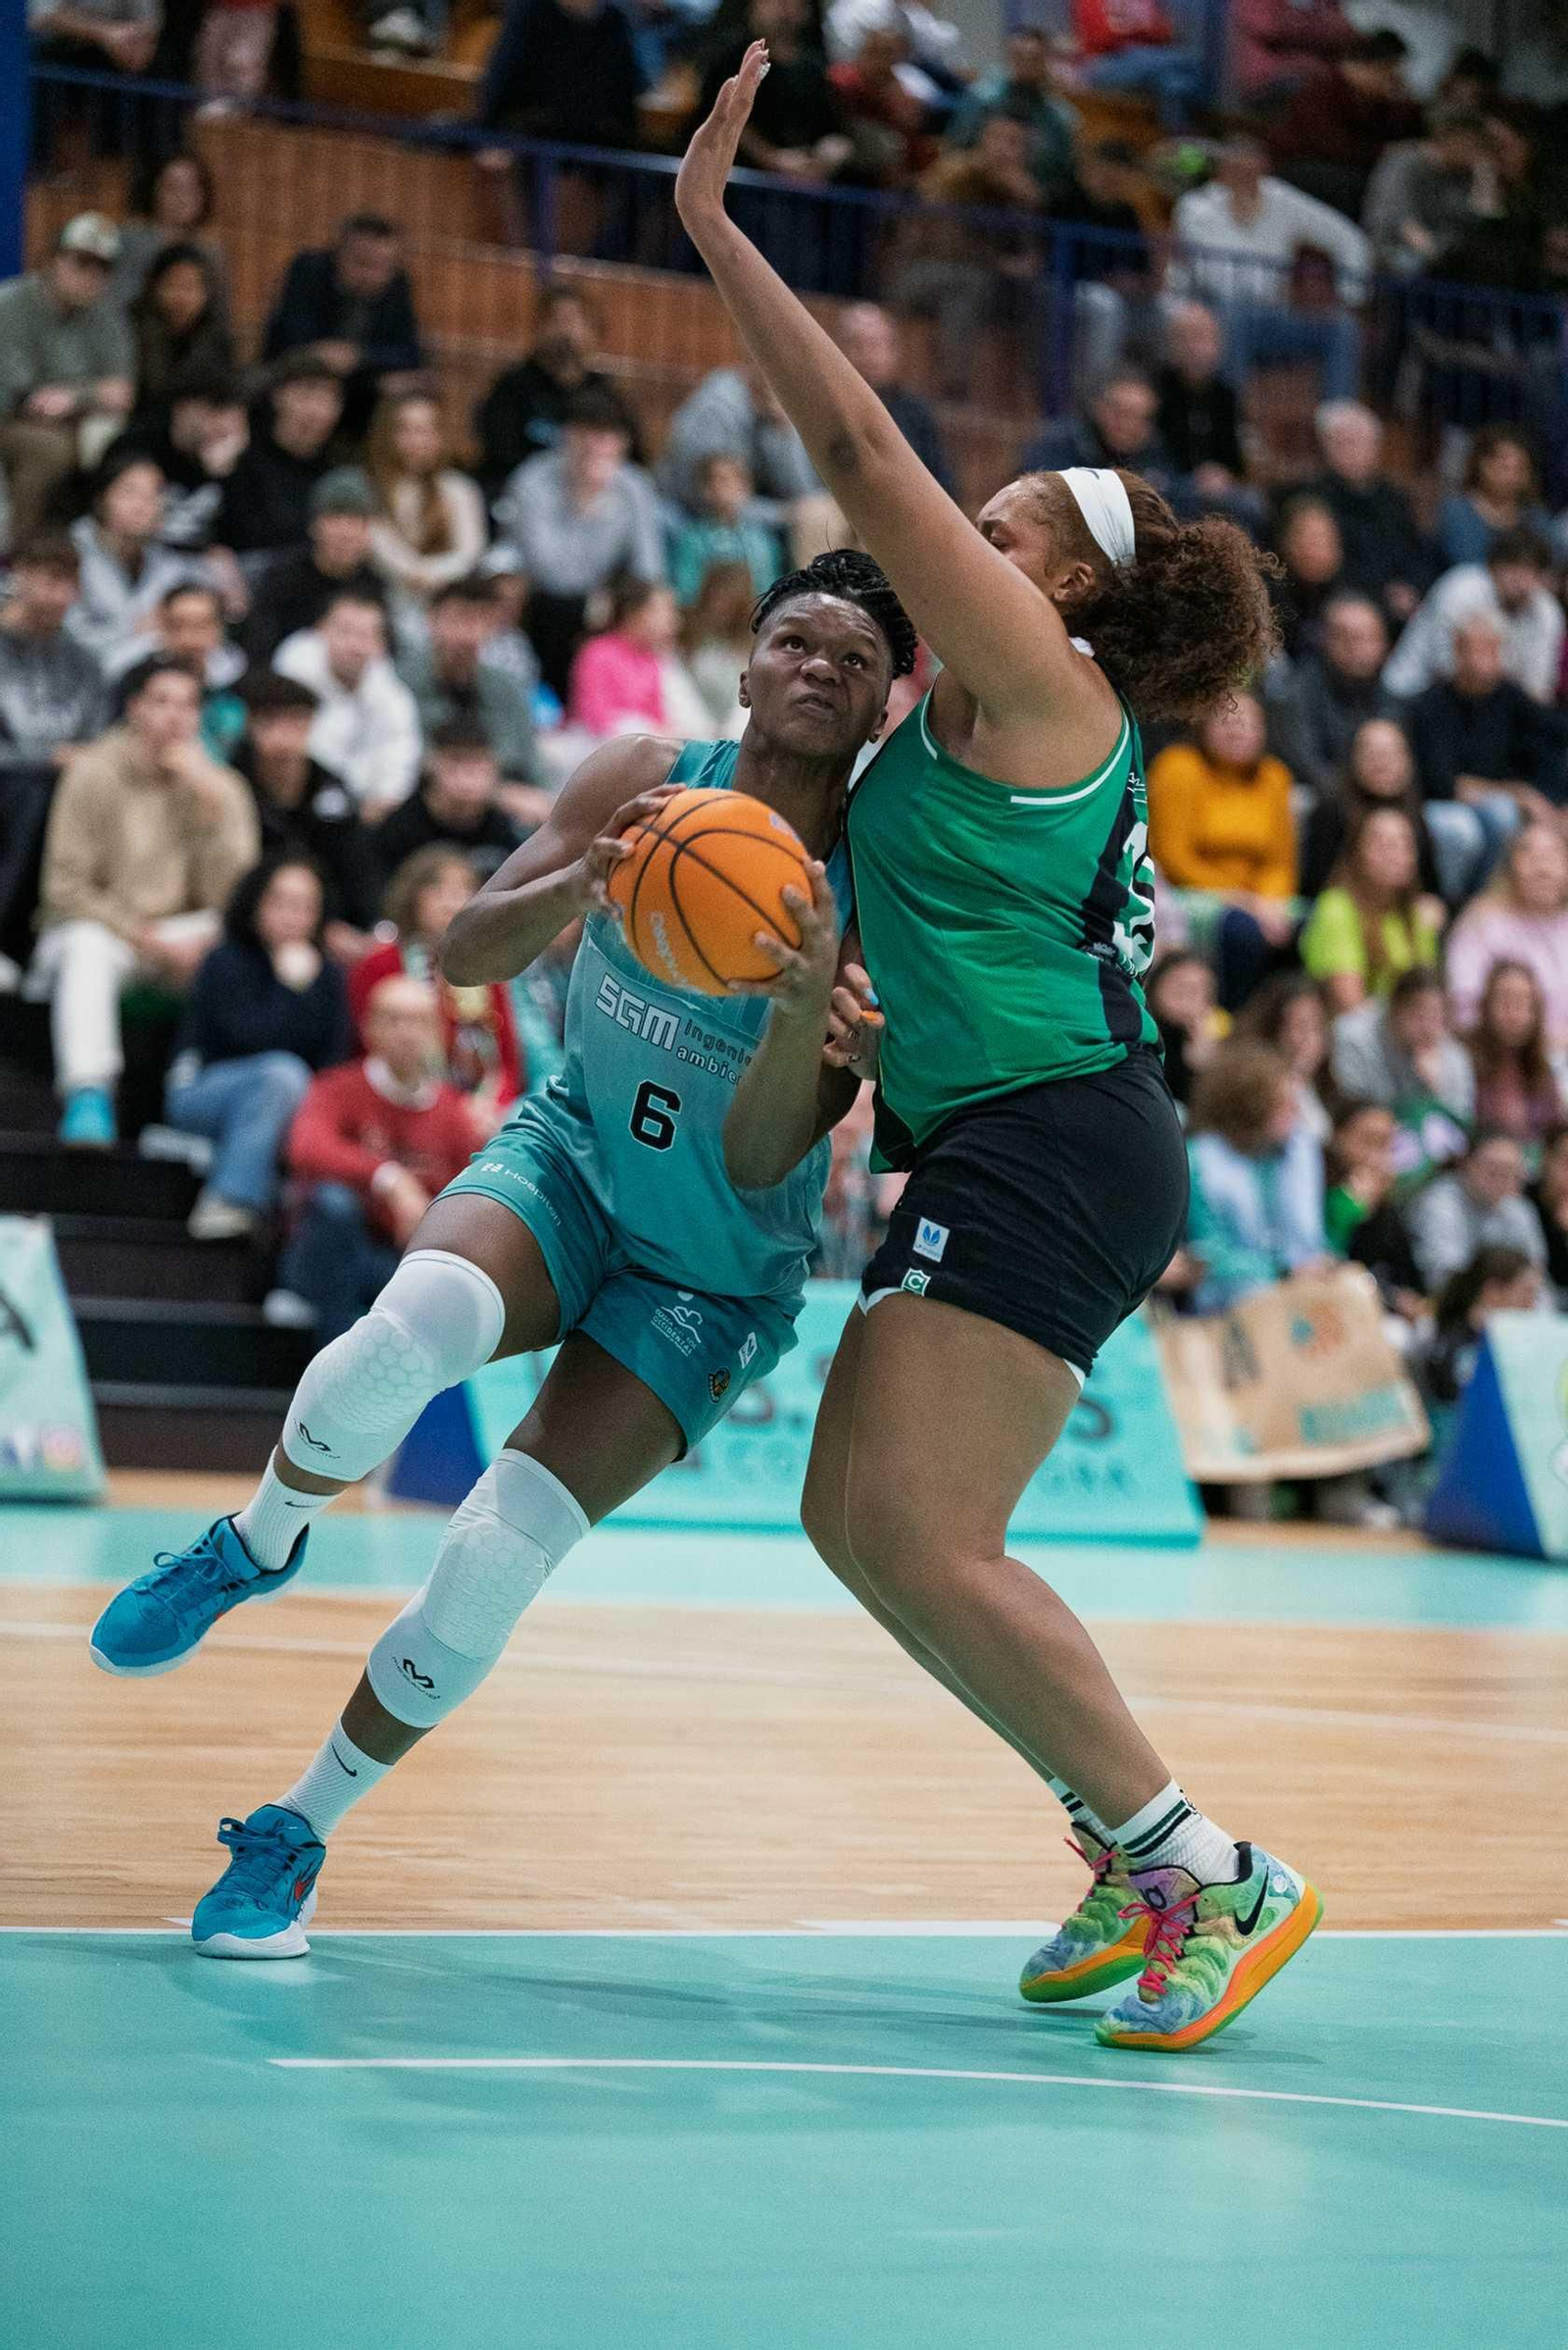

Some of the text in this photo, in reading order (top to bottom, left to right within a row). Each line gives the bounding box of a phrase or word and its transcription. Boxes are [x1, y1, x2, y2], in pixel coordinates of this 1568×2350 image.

[596, 972, 680, 1052] SGM
[676, 1045, 742, 1084] ambie
[628, 1078, 683, 1152] 6
